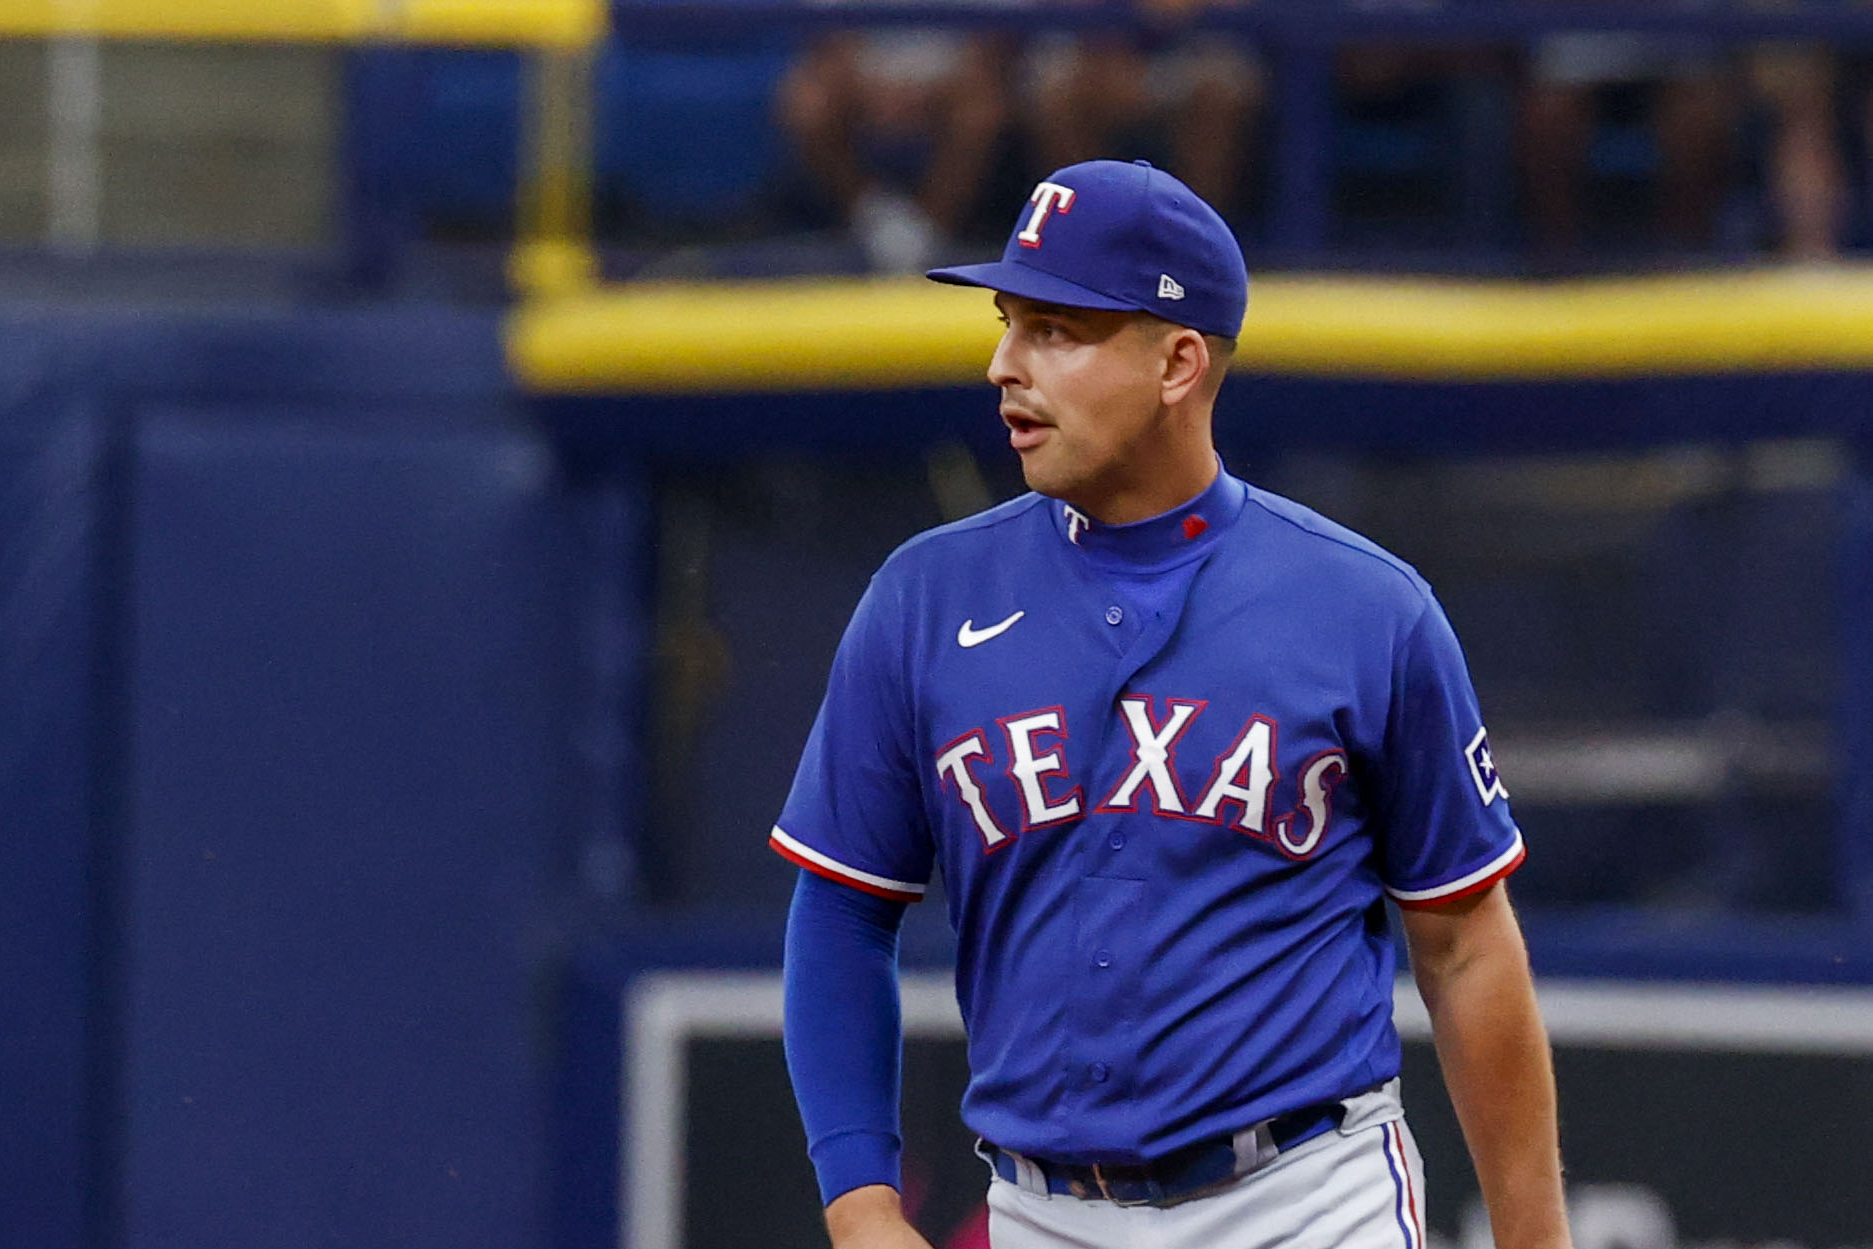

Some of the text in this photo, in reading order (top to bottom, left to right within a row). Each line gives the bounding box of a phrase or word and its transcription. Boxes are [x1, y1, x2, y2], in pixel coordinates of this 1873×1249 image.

[1018, 182, 1077, 249] T
[1063, 504, 1092, 548] T
[934, 694, 1346, 861] TEXAS
